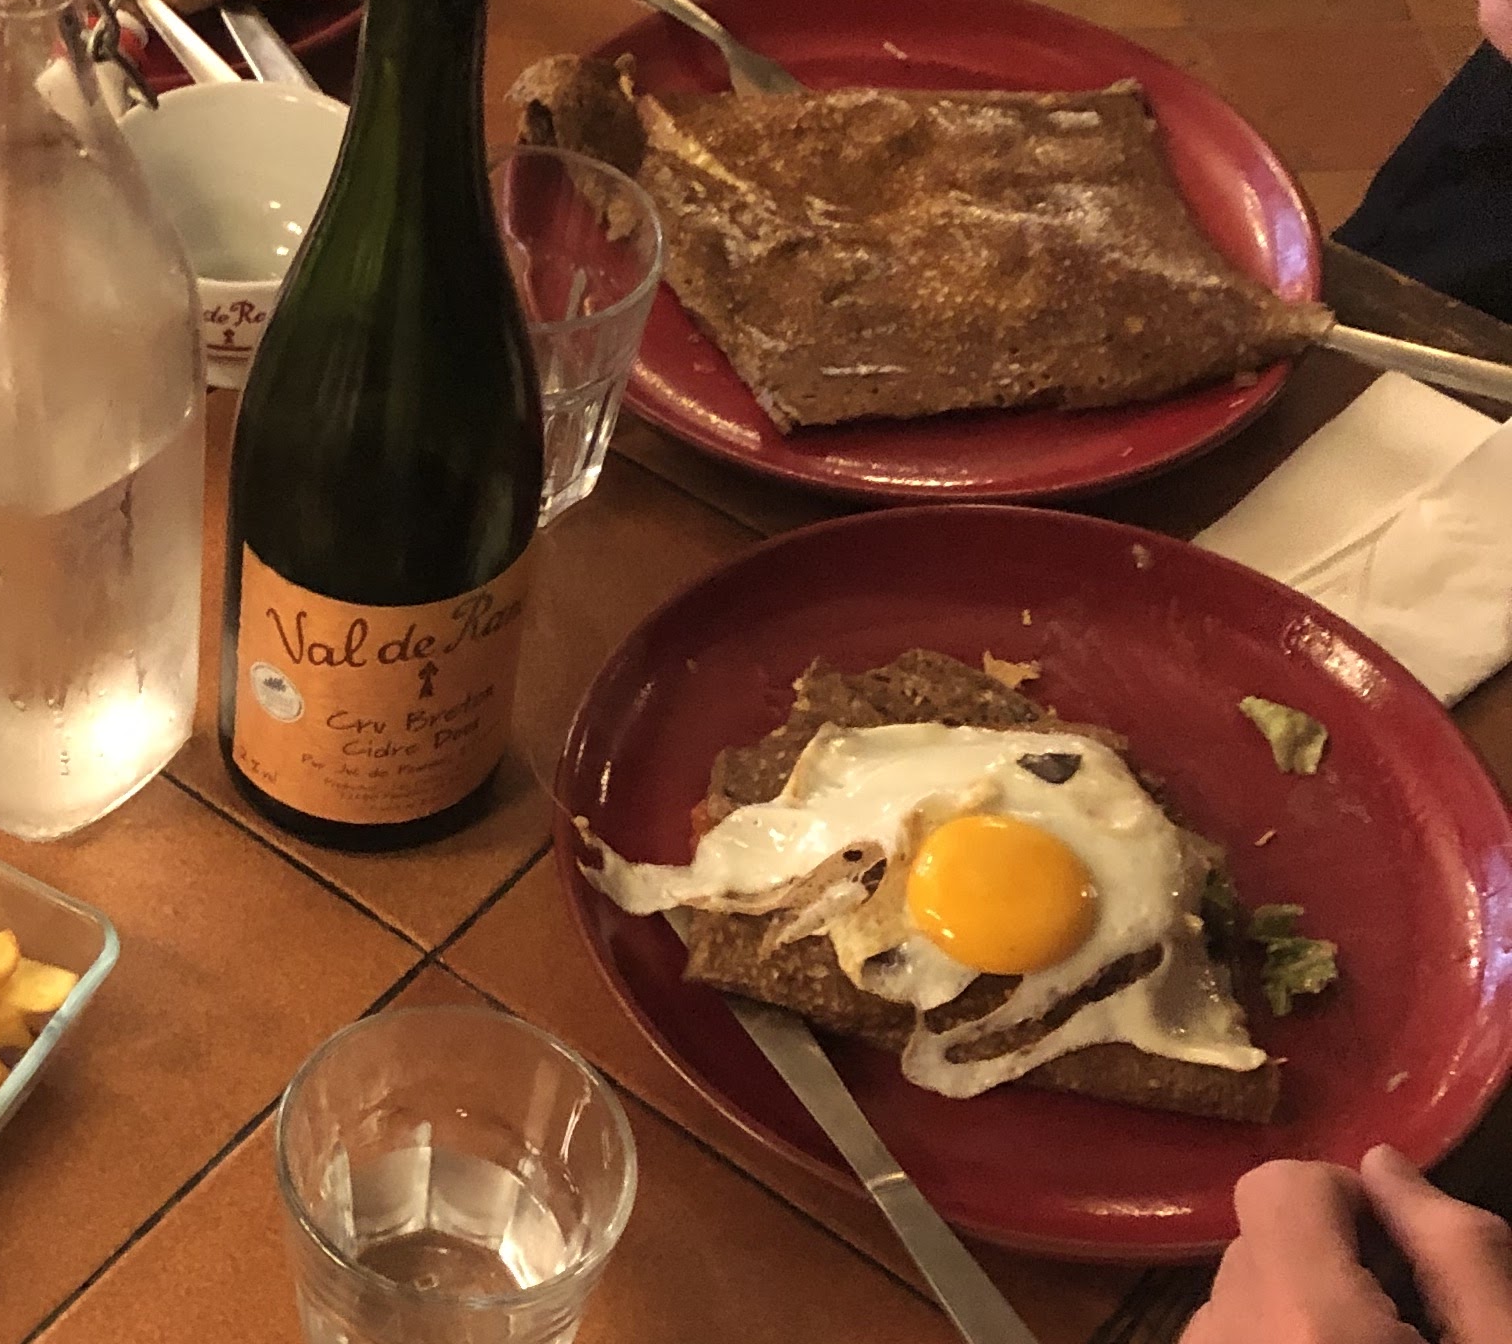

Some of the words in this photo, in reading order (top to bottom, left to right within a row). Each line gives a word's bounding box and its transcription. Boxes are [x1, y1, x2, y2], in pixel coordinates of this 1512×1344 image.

[266, 607, 369, 667] Val
[377, 623, 436, 665] de
[326, 710, 387, 734] Cru
[342, 739, 417, 759] Cidre
